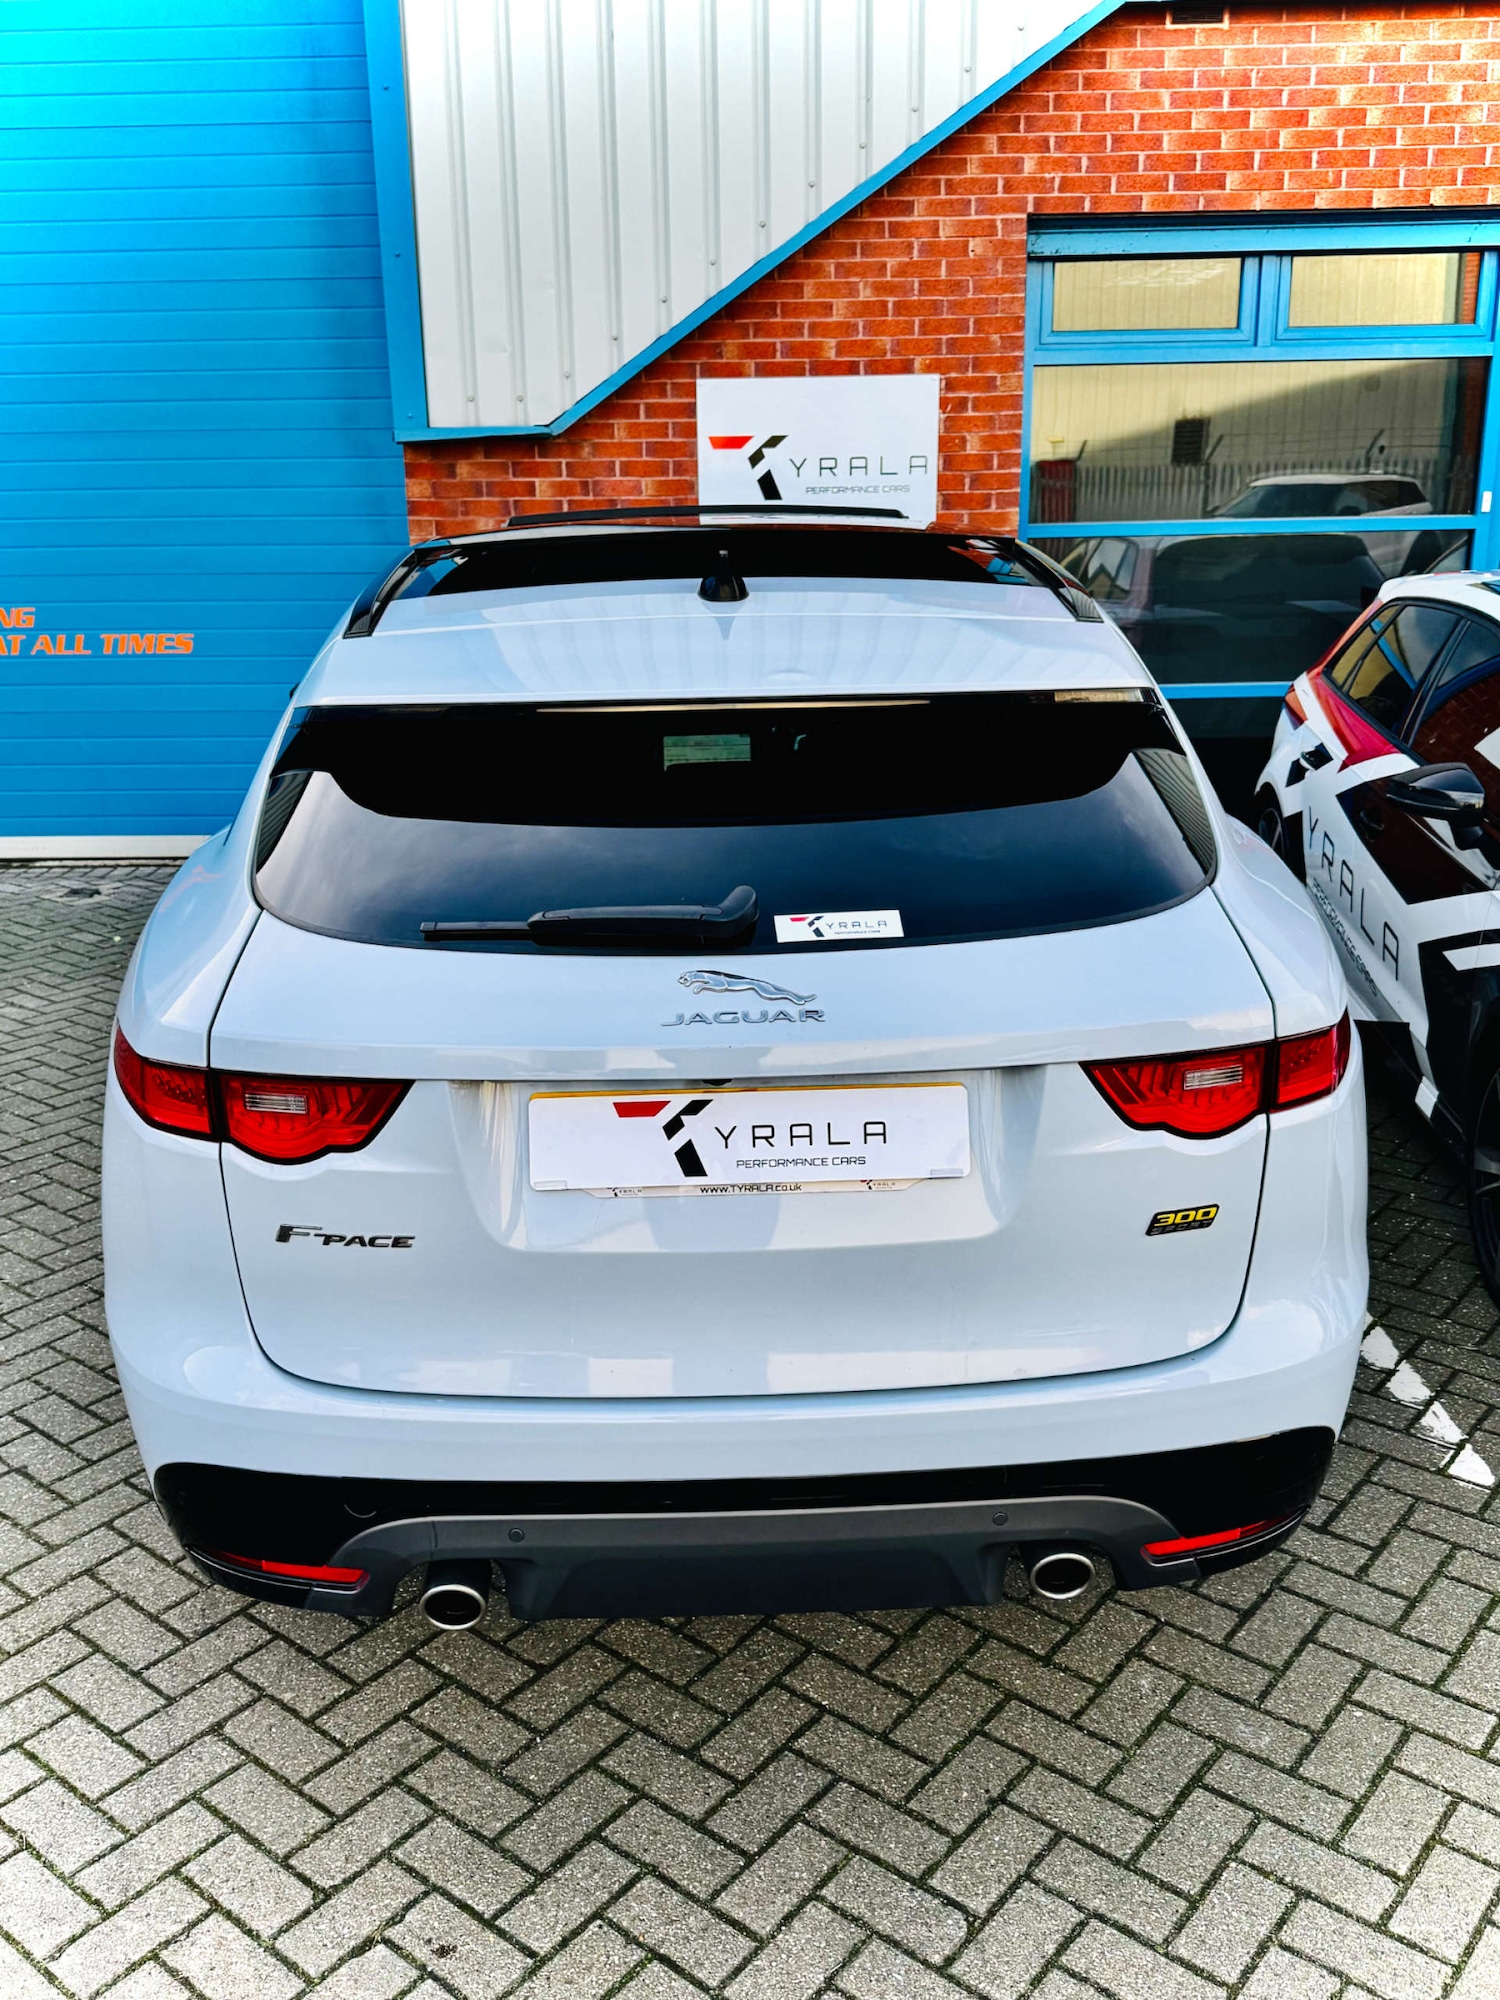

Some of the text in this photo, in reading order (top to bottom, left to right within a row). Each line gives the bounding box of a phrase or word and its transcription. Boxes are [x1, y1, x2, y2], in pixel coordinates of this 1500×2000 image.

[805, 484, 911, 495] PERFORMANCE CARS
[30, 634, 92, 655] ALL
[100, 633, 195, 655] TIMES
[661, 1008, 826, 1026] JAGUAR
[736, 1156, 867, 1169] PERFORMANCE CARS
[1153, 1207, 1218, 1227] 300
